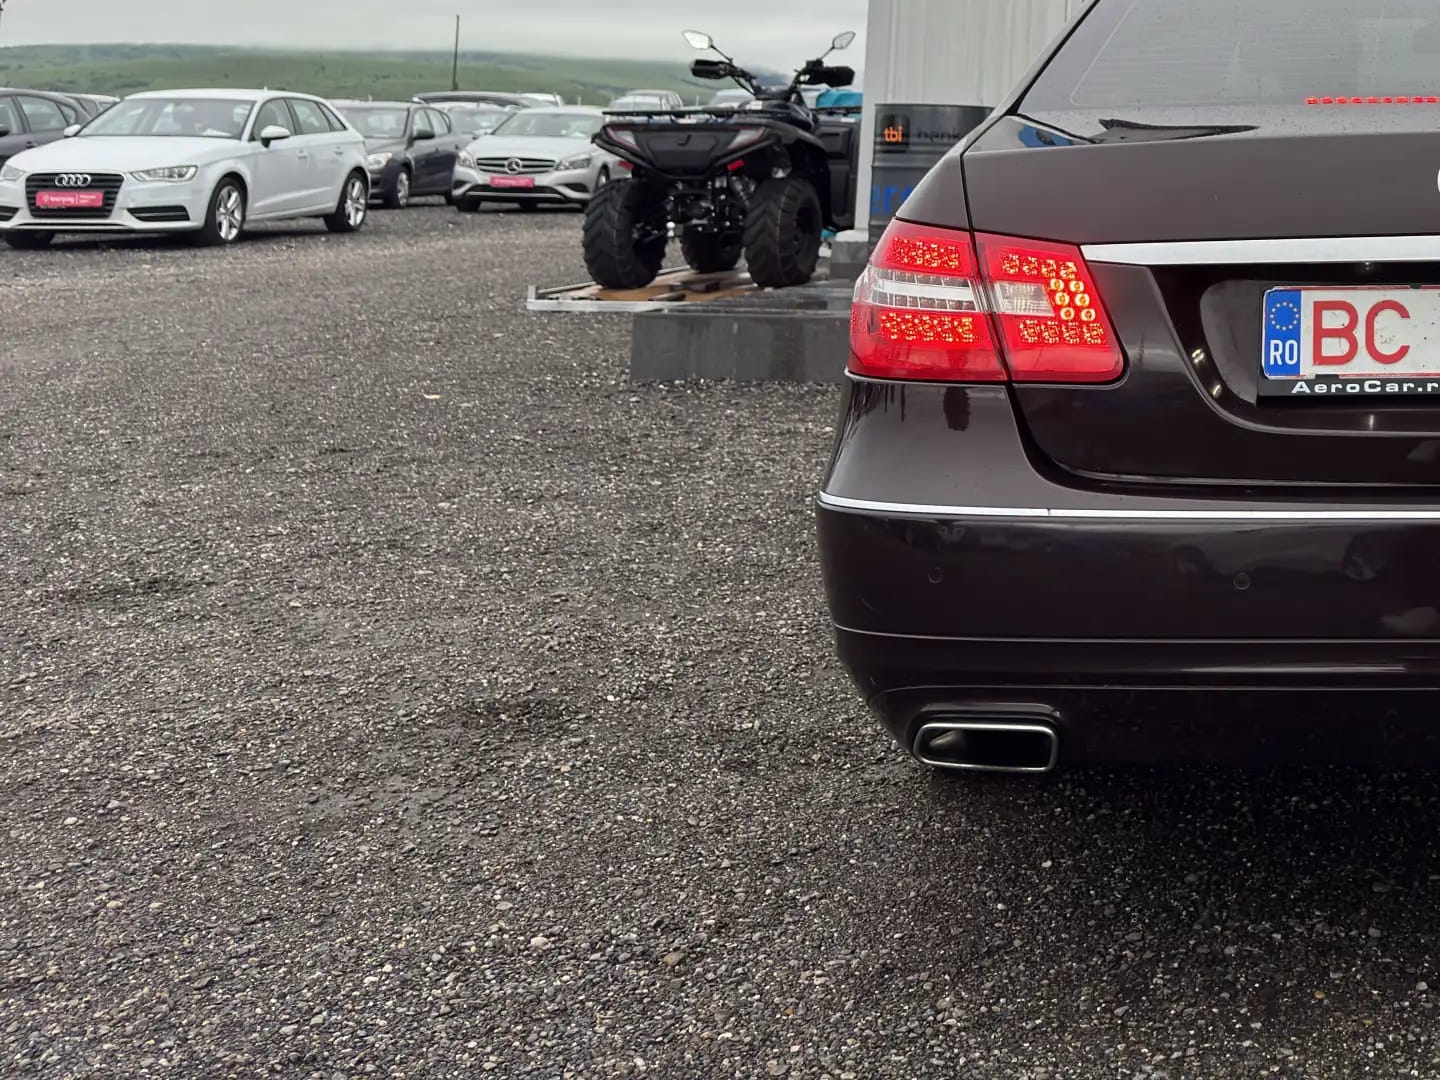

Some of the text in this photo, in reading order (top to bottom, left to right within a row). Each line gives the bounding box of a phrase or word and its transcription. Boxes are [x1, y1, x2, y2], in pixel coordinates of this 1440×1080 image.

[883, 125, 904, 143] tbi
[1313, 299, 1411, 366] BC
[1268, 339, 1299, 366] RO
